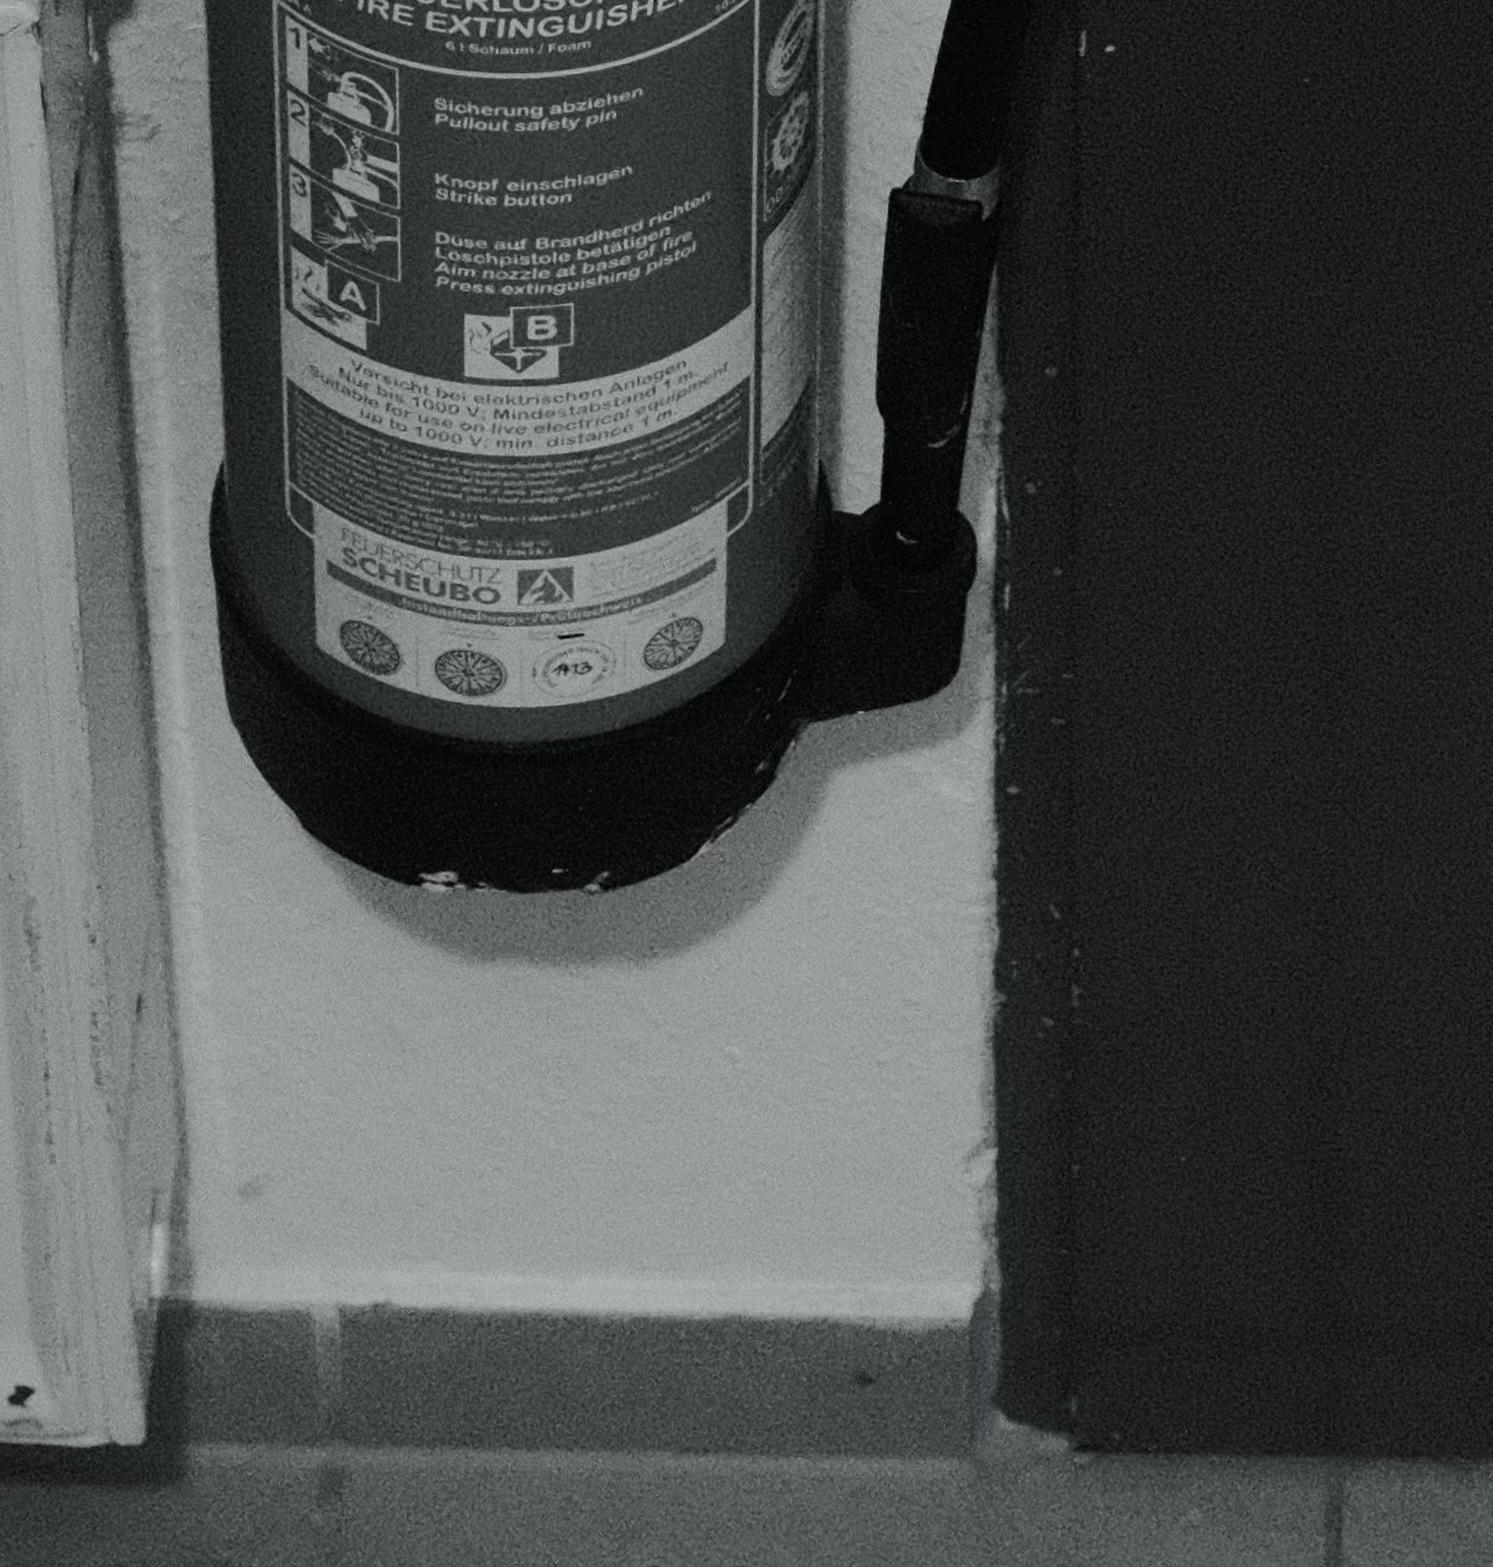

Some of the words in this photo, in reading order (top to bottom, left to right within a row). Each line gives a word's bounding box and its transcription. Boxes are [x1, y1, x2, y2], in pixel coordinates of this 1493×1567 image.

[290, 26, 301, 50] 1
[468, 42, 535, 56] Schaum
[548, 39, 592, 54] Foam
[290, 98, 307, 127] 2
[434, 97, 544, 119] Sicherung
[549, 87, 645, 116] abziehen
[434, 112, 509, 133] Pullout
[514, 116, 581, 132] safety
[585, 108, 618, 129] pin
[291, 172, 308, 198] 3
[434, 172, 499, 193] Knopf
[506, 164, 634, 193] einschlagen
[435, 187, 498, 207] Strike
[503, 192, 573, 208] button
[435, 231, 488, 250] Düse
[494, 237, 528, 251] auf
[535, 221, 644, 250] Brandherd
[648, 190, 713, 228] richten
[435, 247, 571, 267] Löschpistole
[576, 225, 672, 260] betätigen
[435, 261, 477, 278] Aim
[482, 267, 551, 281] nozzle
[555, 264, 576, 278] at
[581, 255, 631, 275] base
[636, 244, 658, 261] of
[661, 229, 694, 253] fire
[435, 276, 495, 294] Press
[501, 266, 641, 297] extinguishing
[645, 242, 698, 276] pistol
[339, 280, 367, 312] A
[526, 314, 558, 341] B
[308, 364, 379, 409] Suitable
[385, 402, 411, 419] for
[418, 413, 454, 429] use
[460, 421, 485, 433] on
[491, 421, 527, 435] live
[534, 407, 631, 435] electrical
[635, 361, 730, 416] equipment
[337, 366, 372, 390] Nur
[377, 383, 408, 403] bis
[412, 395, 461, 415] 1000
[493, 384, 657, 421] Mindestabstand
[351, 359, 429, 395] Vorsicht
[436, 386, 467, 402] bei
[609, 360, 687, 394] Anlagen
[359, 408, 383, 425] up
[389, 418, 409, 433] to
[416, 425, 464, 445] 1000
[546, 420, 634, 448] distance
[340, 528, 503, 585] FEUERSCHUTZ
[341, 547, 502, 606] SCHEUBO
